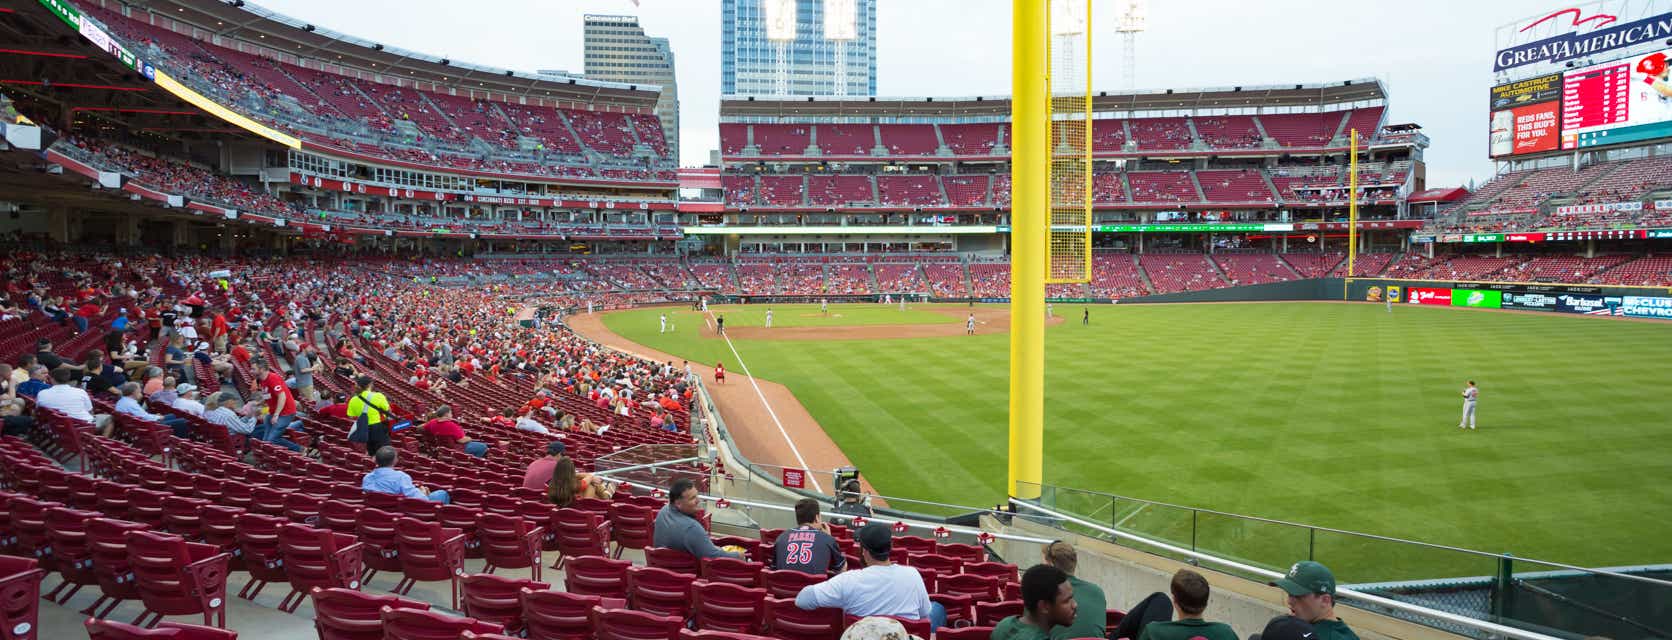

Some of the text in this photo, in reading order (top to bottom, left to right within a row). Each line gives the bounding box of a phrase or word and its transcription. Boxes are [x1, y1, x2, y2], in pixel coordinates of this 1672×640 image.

[1497, 42, 1560, 68] GREAT
[1493, 84, 1511, 94] MIKE
[1512, 74, 1559, 90] CASTRUCCI
[1500, 83, 1550, 98] AUTOMOTIVE
[1517, 114, 1535, 123] REDS
[1536, 111, 1556, 121] FANS,
[1517, 122, 1533, 131] THIS
[1533, 119, 1556, 129] BUD'S
[1517, 129, 1548, 140] FOR YOU.
[786, 543, 813, 564] 25
